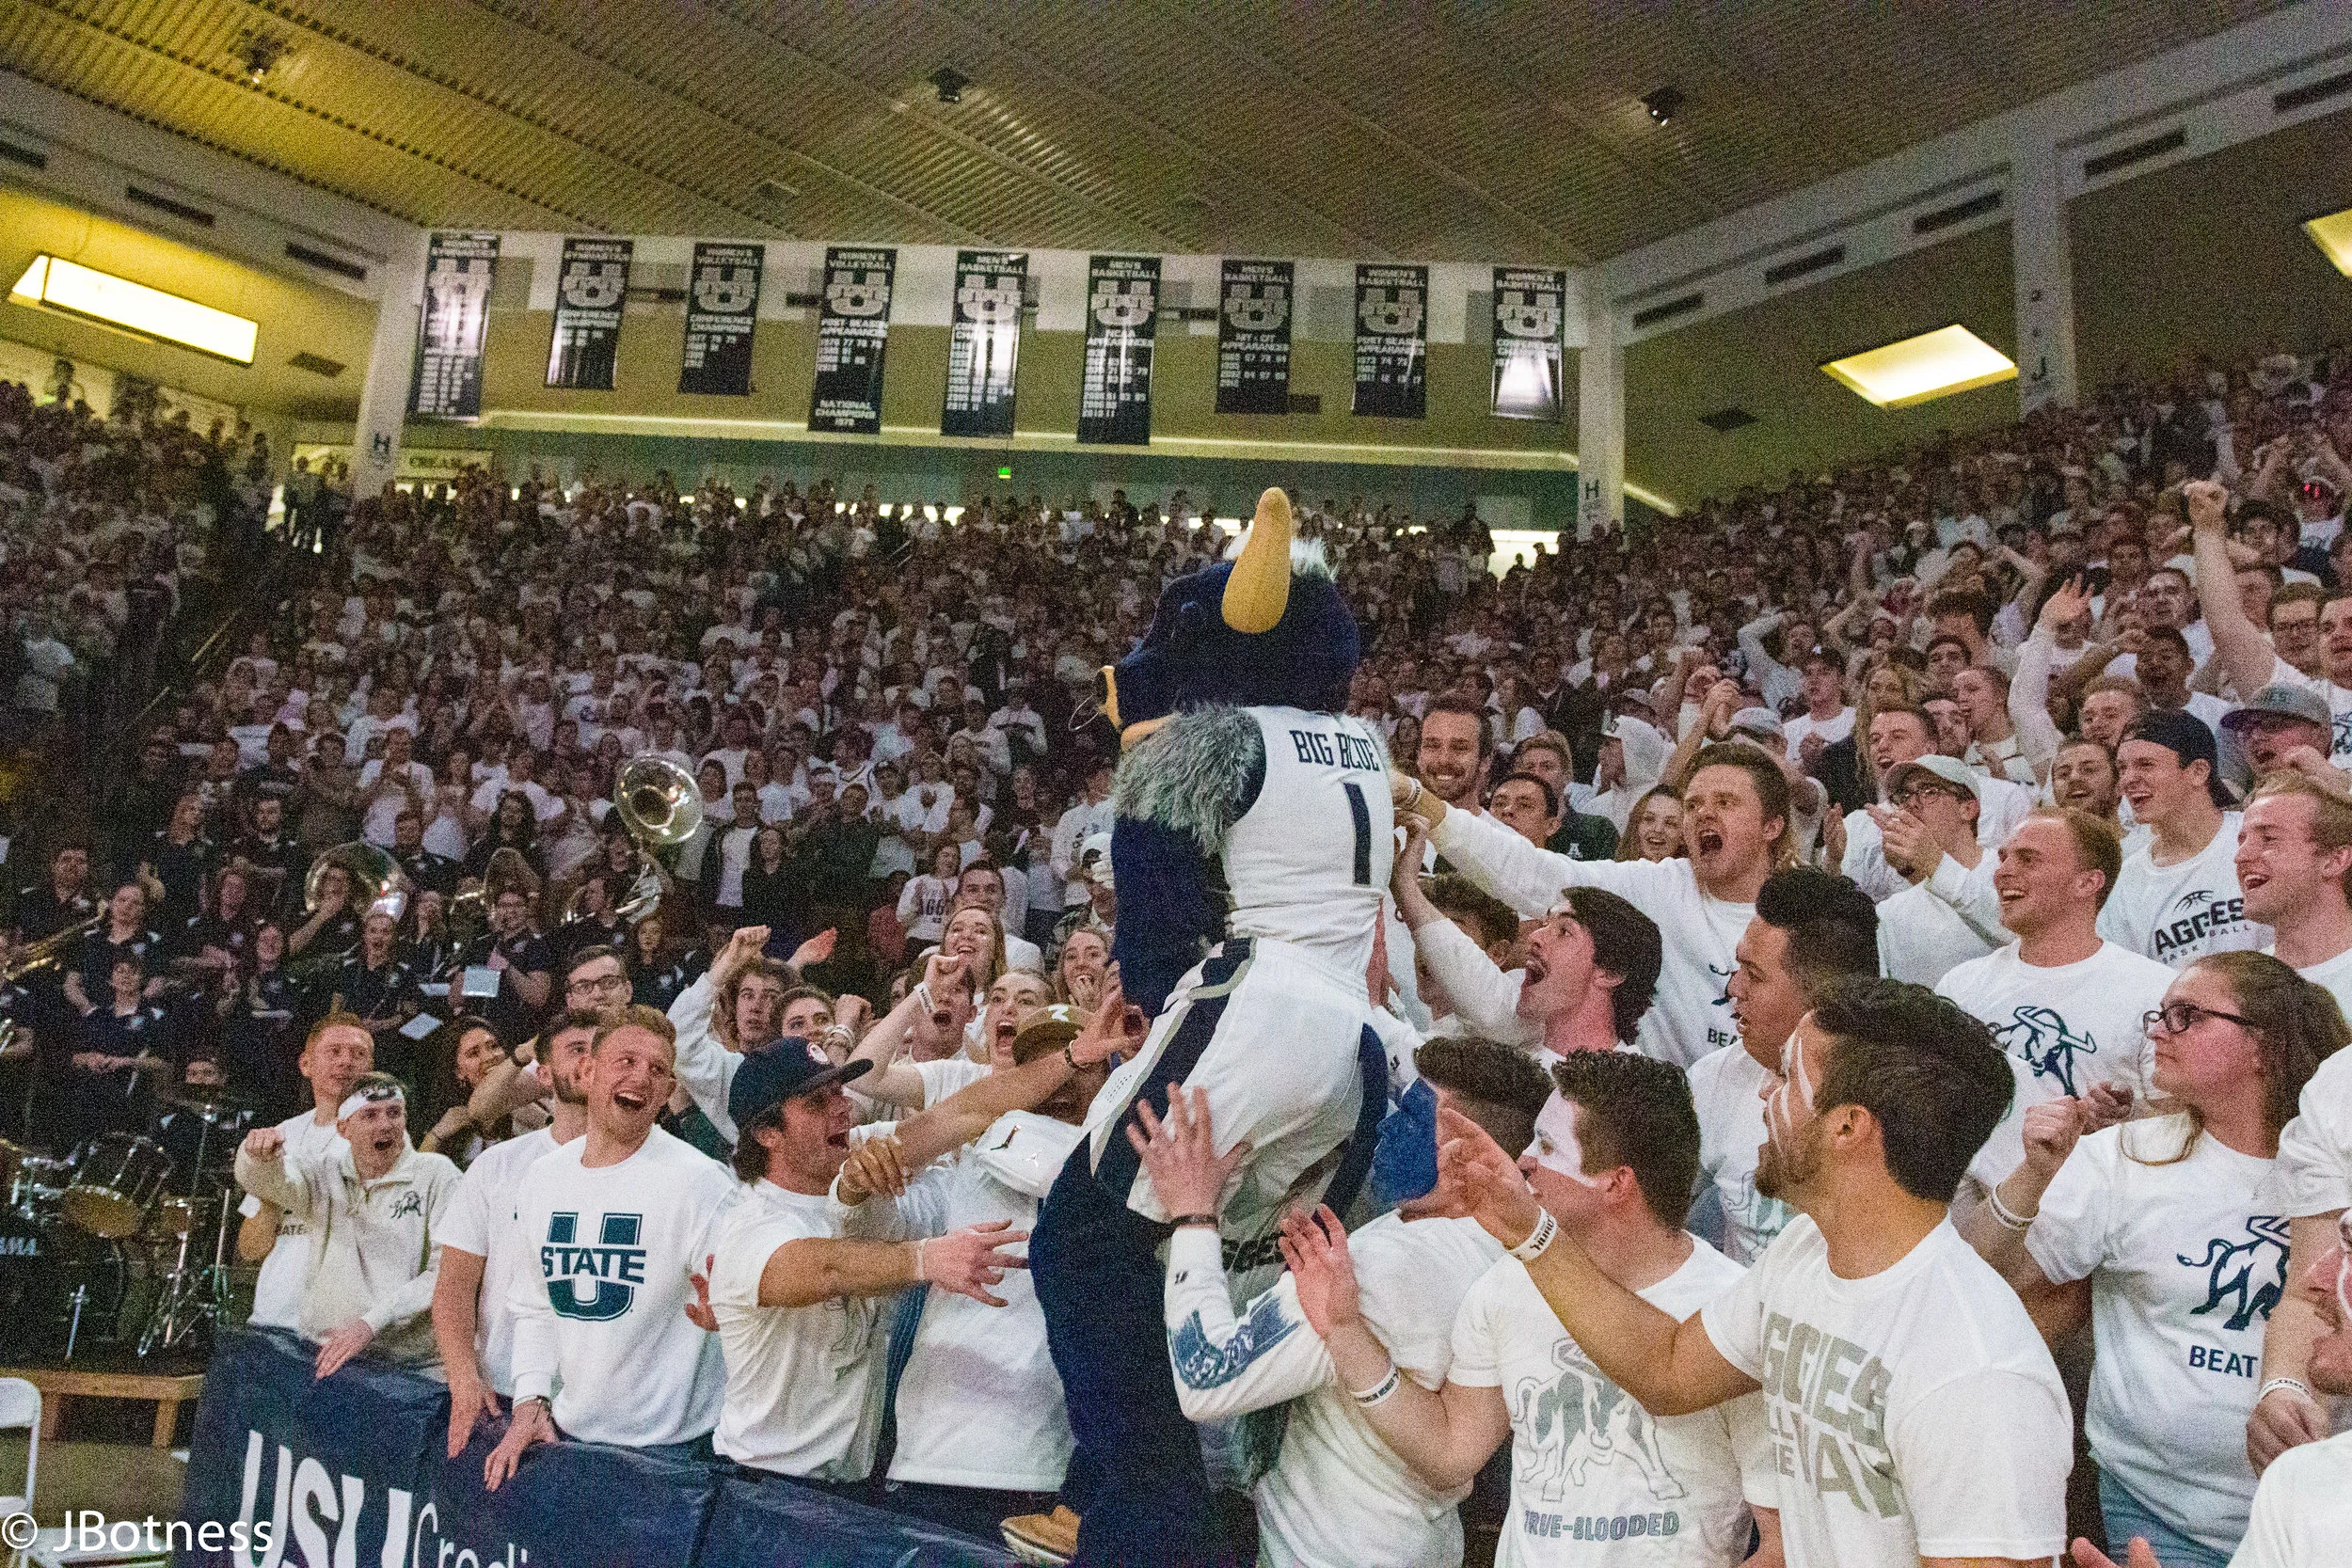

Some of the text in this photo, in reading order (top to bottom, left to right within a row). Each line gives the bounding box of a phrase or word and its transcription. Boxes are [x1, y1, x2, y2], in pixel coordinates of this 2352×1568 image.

[1585, 478, 1600, 499] H
[1289, 730, 1381, 771] BIG BLUE
[1343, 782, 1373, 887] 1
[1708, 1027, 1738, 1048] BEA
[540, 1245, 648, 1285] STATE
[546, 1212, 644, 1323] U
[1758, 1303, 1894, 1457] GGIES
[2188, 1344, 2259, 1379] BEAT
